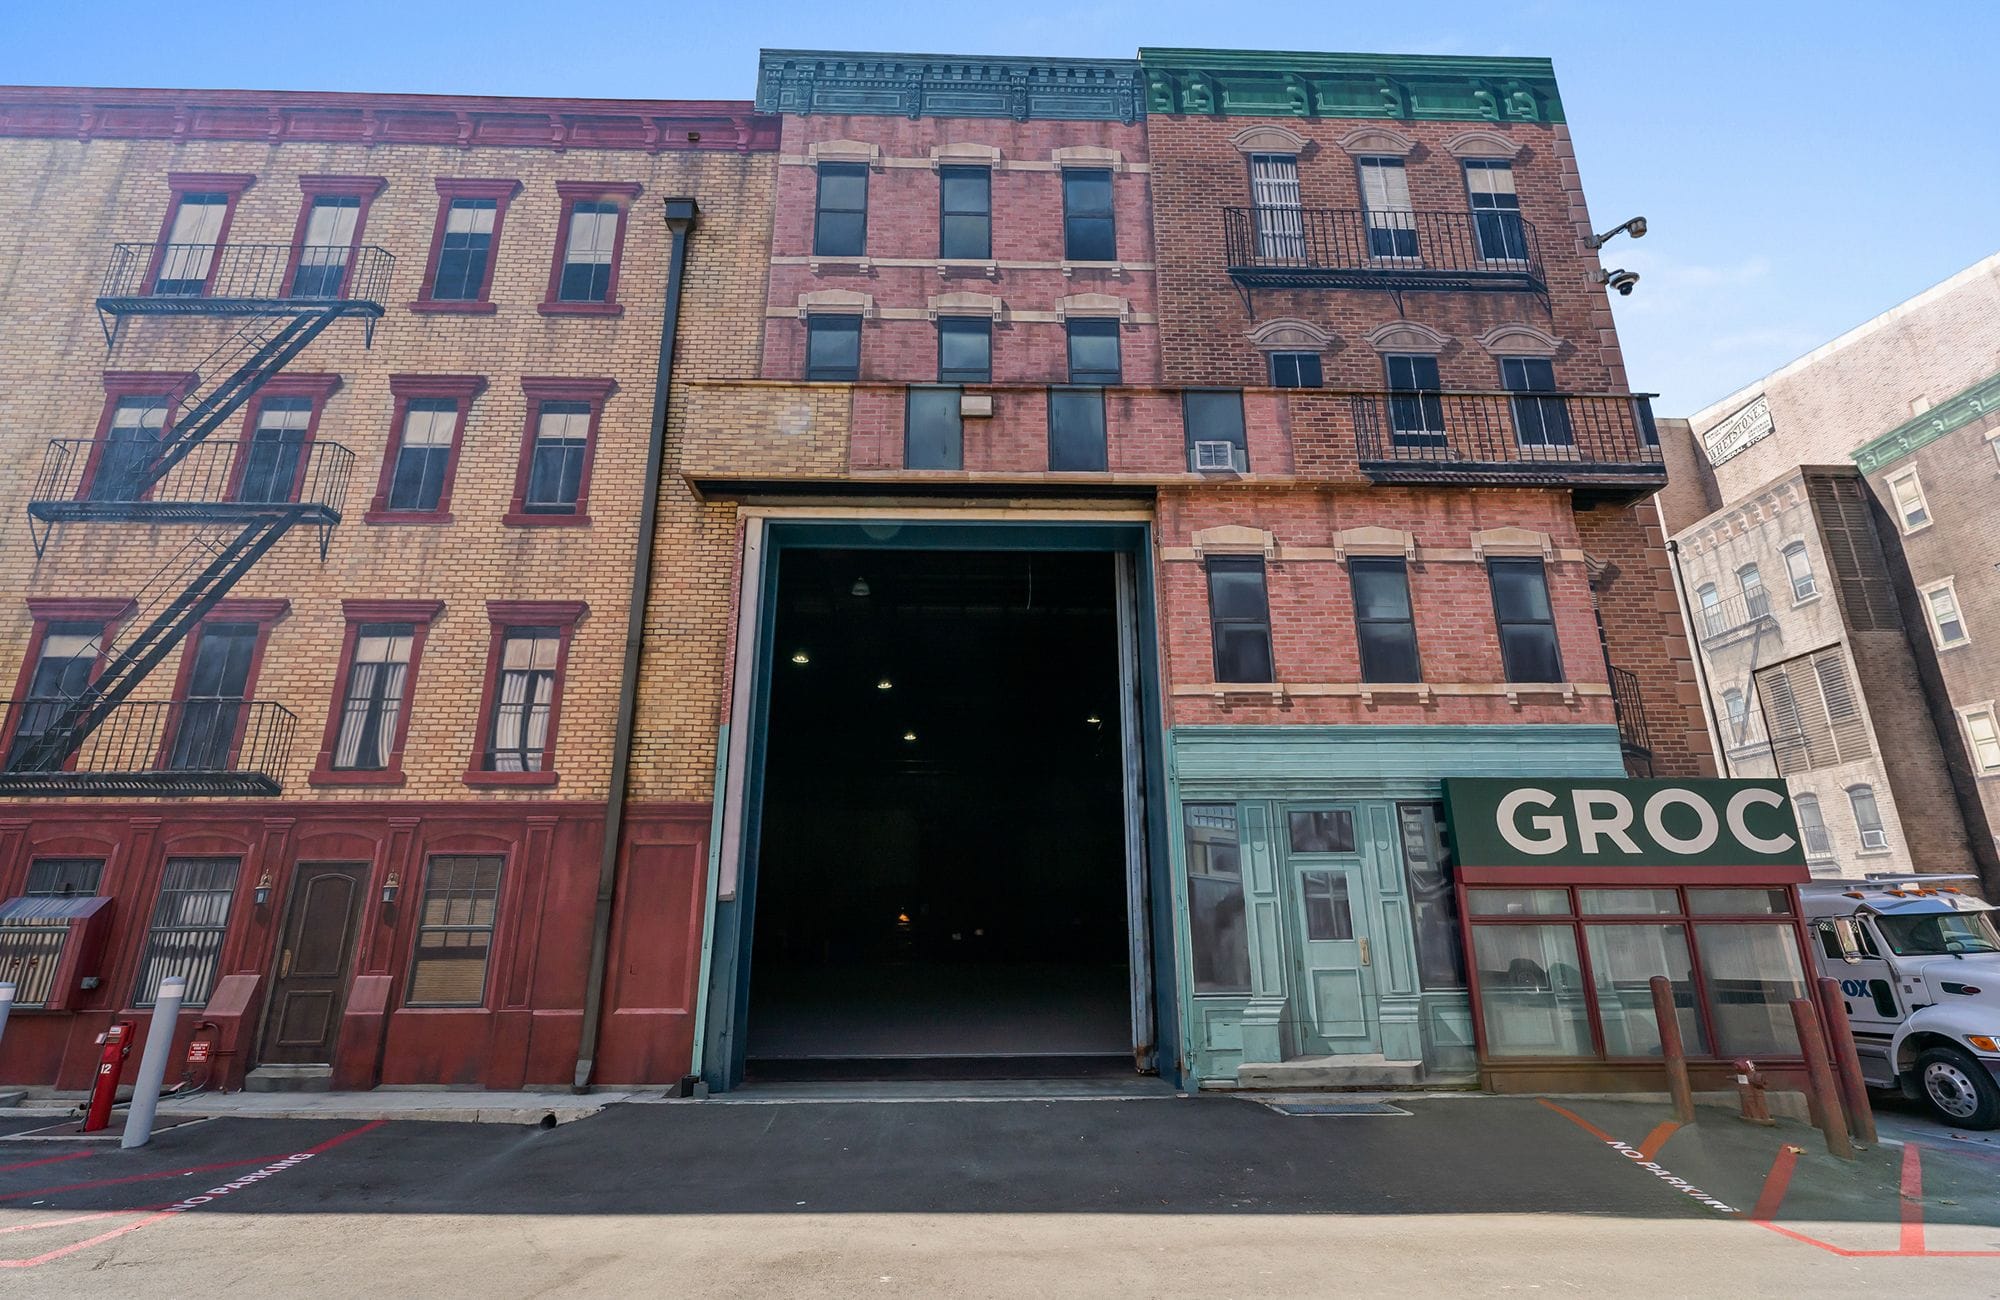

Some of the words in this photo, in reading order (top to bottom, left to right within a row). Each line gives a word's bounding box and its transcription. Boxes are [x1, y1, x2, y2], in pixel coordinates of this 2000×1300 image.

[1707, 401, 1768, 460] WHETSTONE'S
[1714, 447, 1746, 467] GENERAL
[1746, 430, 1770, 448] STORE
[1496, 788, 1796, 855] GROC
[1838, 979, 1873, 998] OX
[100, 1063, 112, 1074] 12
[1606, 1141, 1644, 1159] NO
[161, 1196, 214, 1212] NO
[205, 1153, 315, 1194] PARKING
